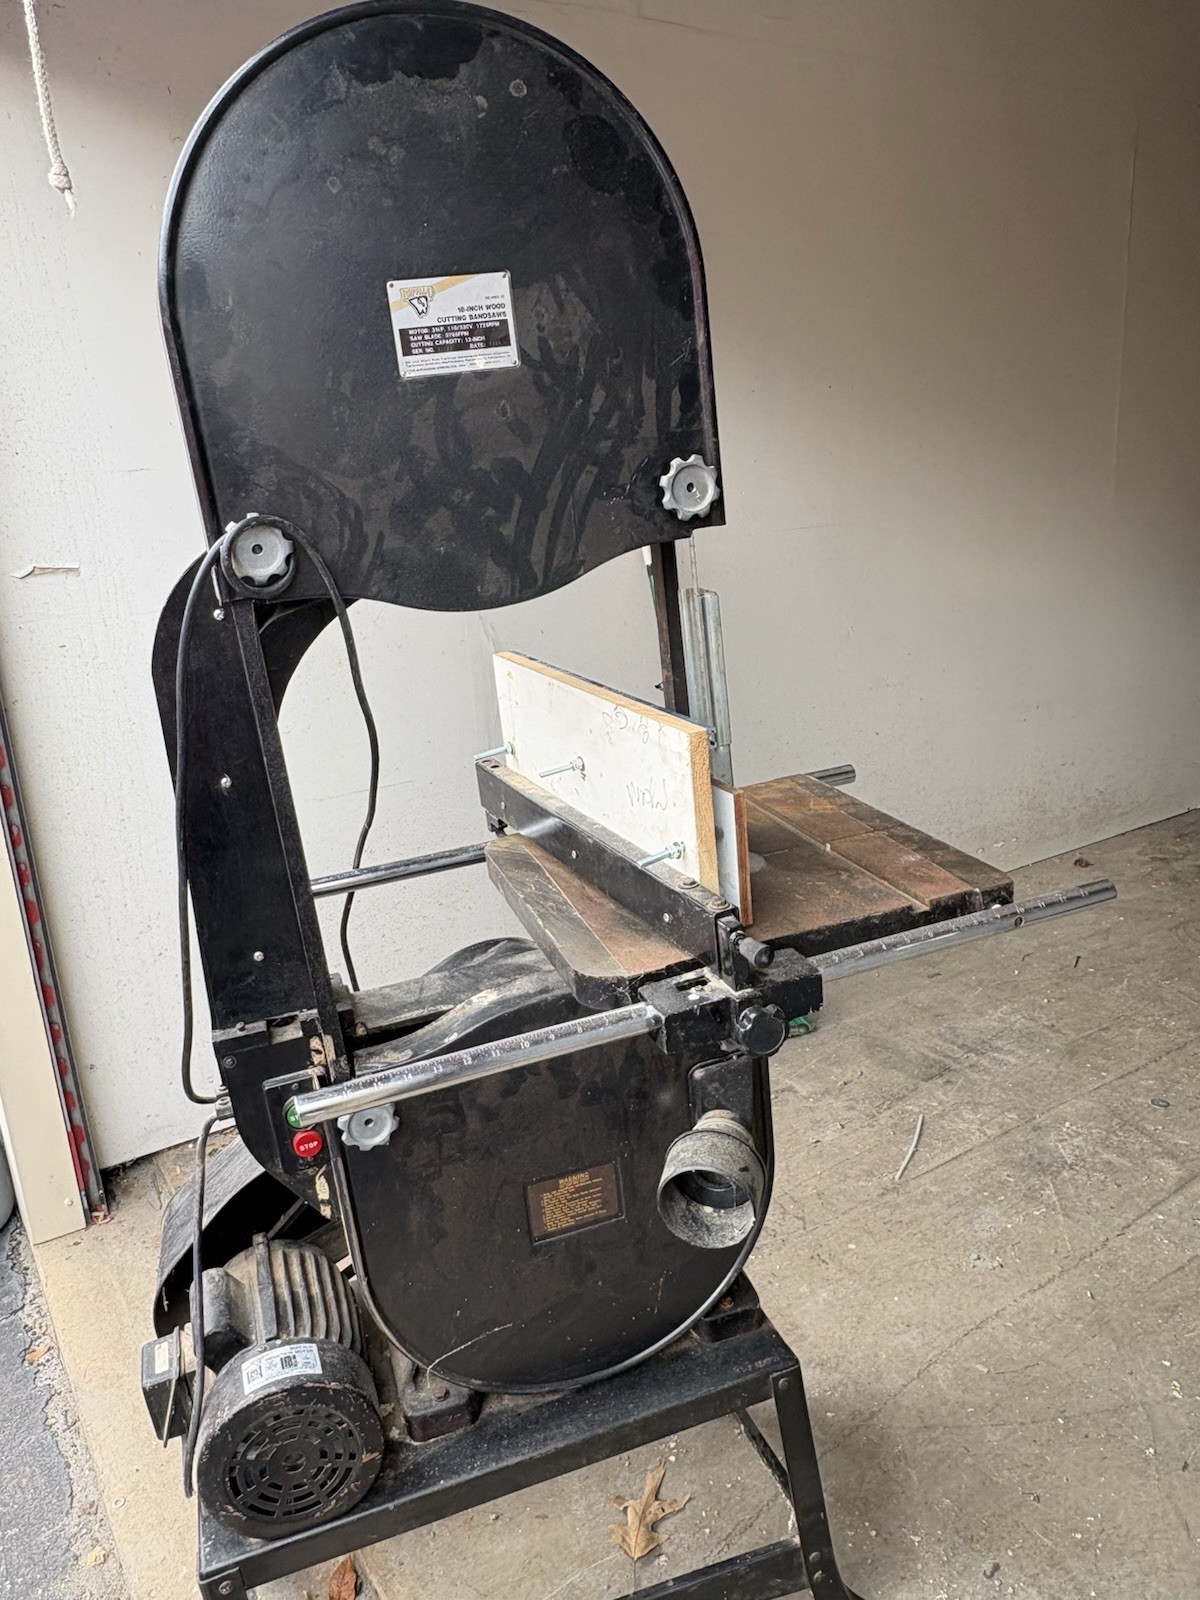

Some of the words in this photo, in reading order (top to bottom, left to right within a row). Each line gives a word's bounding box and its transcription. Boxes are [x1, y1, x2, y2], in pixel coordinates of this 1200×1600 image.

[437, 315, 467, 323] CUTTING
[468, 311, 507, 321] BANDSAWS
[403, 1073, 413, 1082] 14
[433, 1063, 443, 1073] 13
[463, 1057, 473, 1067] 12
[491, 1049, 501, 1058] 11
[520, 1040, 531, 1050] 10
[299, 1140, 319, 1151] STOP
[558, 1171, 590, 1185] WARNING
